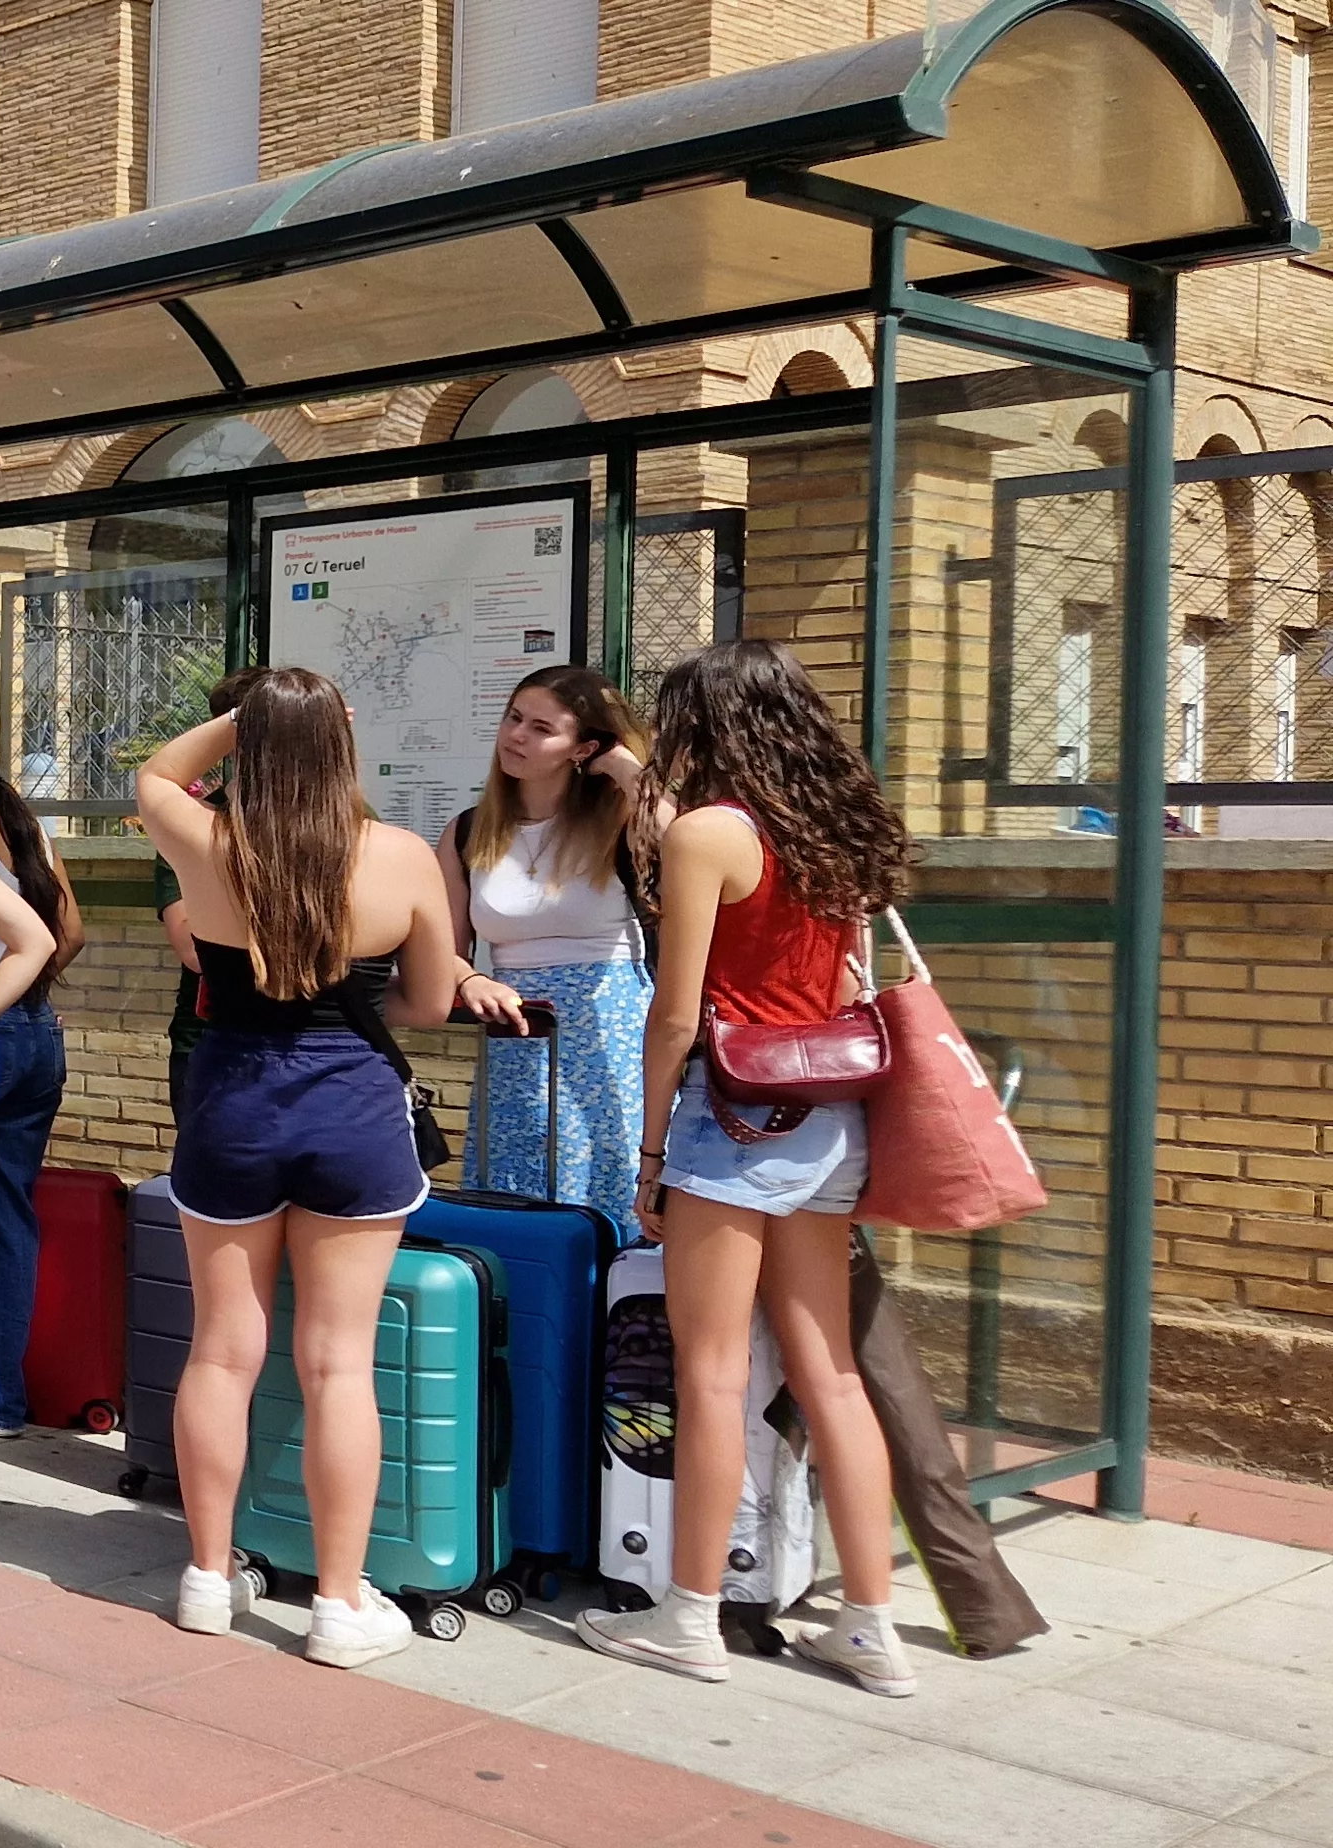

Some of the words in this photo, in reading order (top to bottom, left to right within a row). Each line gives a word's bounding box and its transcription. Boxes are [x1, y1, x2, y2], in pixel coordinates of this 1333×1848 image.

[284, 563, 300, 577] 07
[304, 561, 318, 575] C/
[322, 556, 365, 573] Teruel
